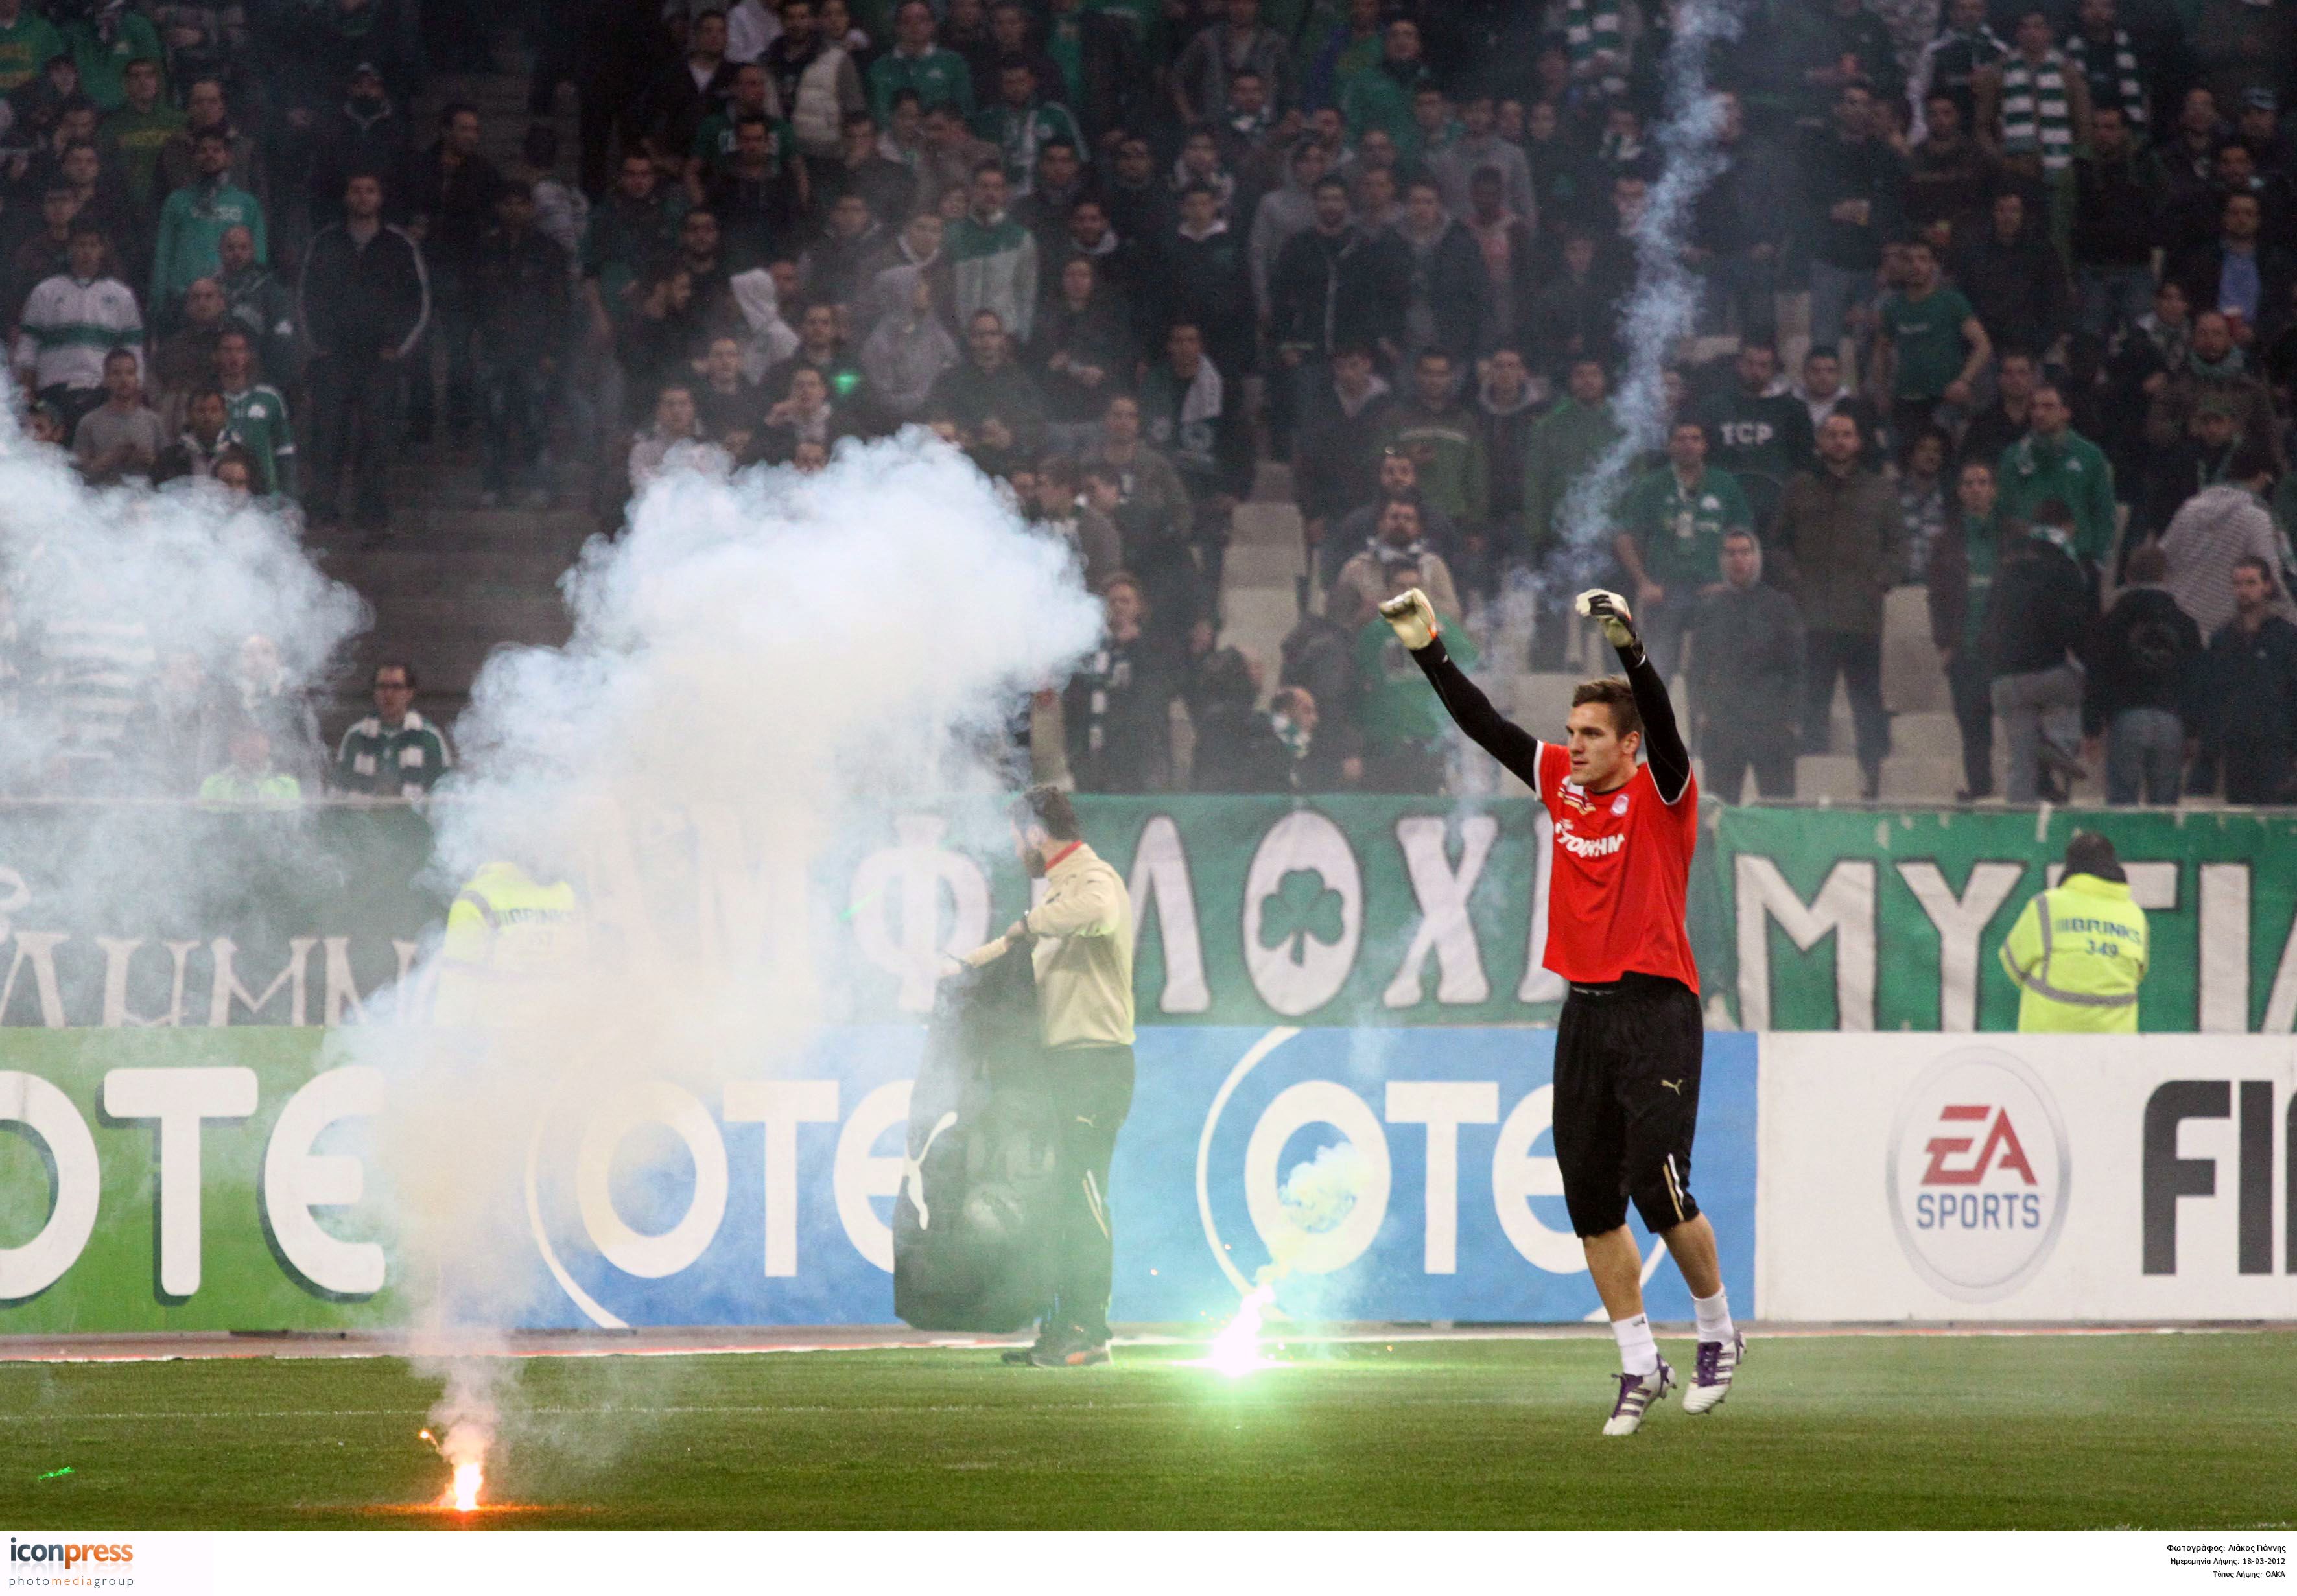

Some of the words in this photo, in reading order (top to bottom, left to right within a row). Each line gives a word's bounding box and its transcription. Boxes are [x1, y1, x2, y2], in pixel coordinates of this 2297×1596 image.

[2085, 939, 2119, 959] 349
[1920, 1105, 2038, 1186] EA
[2142, 1079, 2297, 1276] FI
[1916, 1193, 2041, 1230] SPORTS
